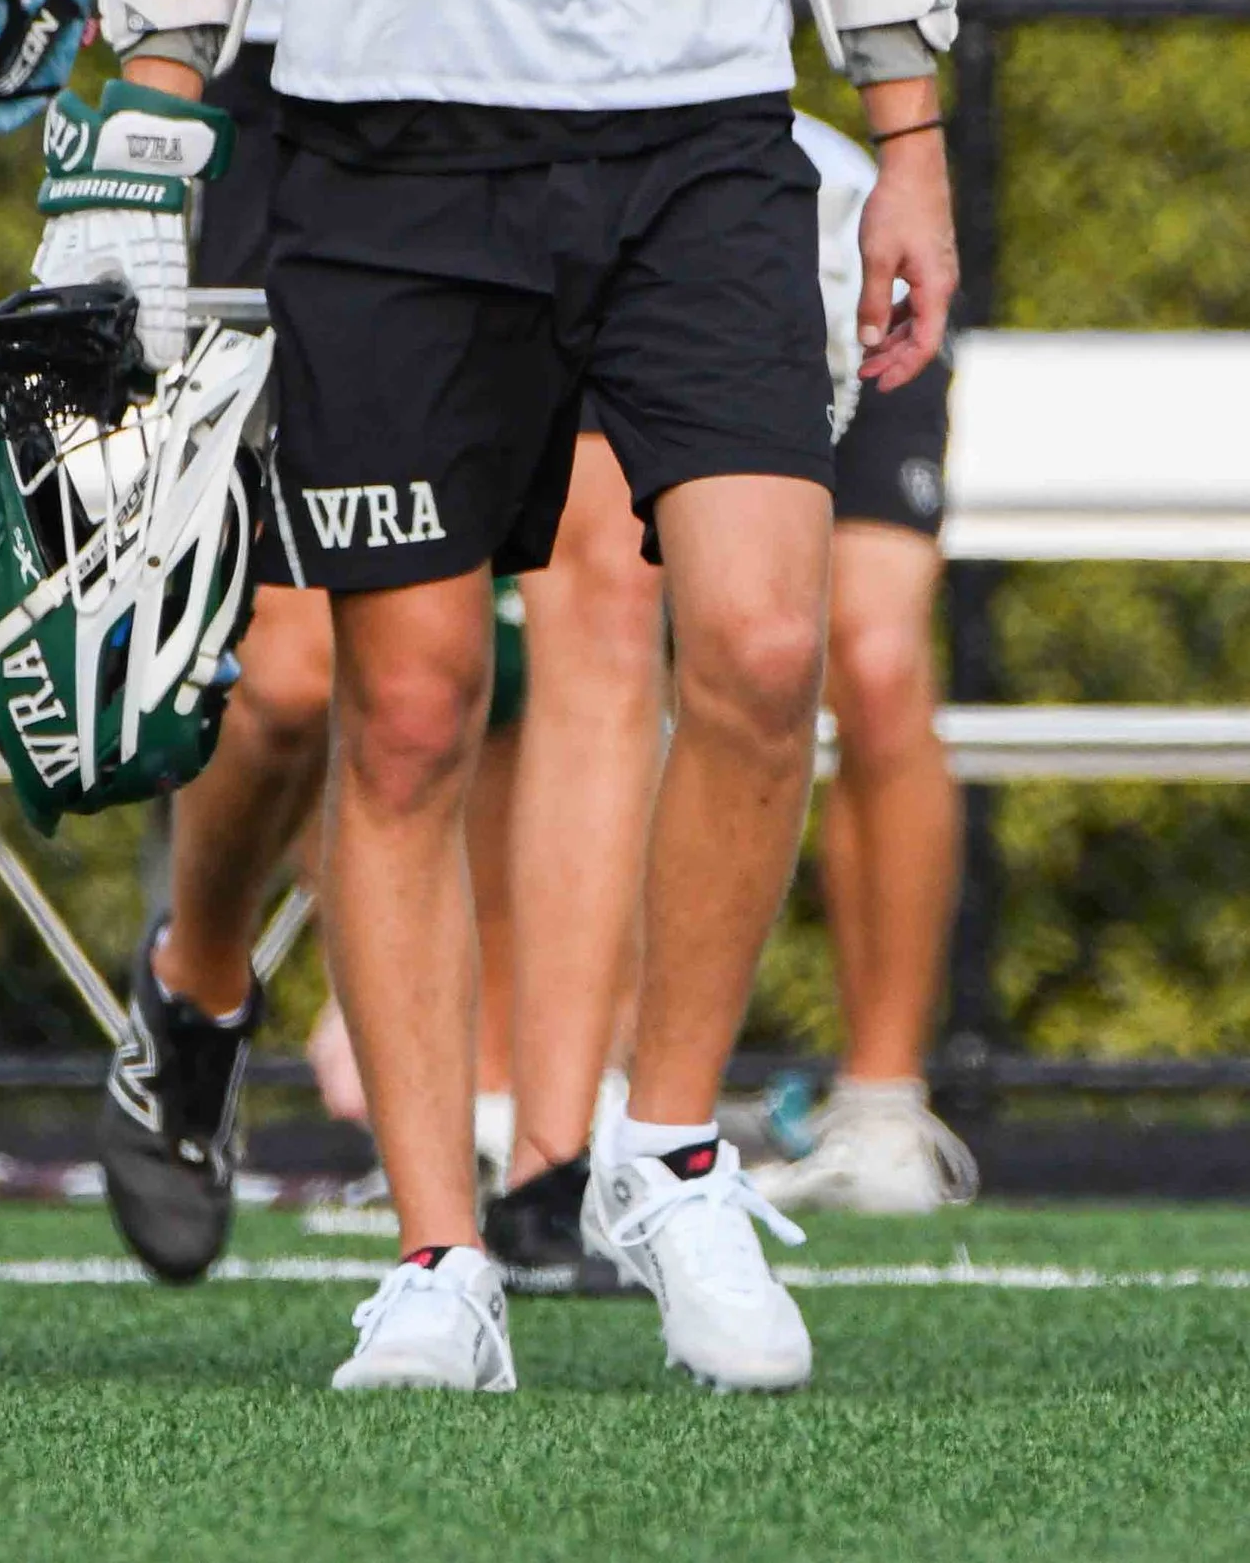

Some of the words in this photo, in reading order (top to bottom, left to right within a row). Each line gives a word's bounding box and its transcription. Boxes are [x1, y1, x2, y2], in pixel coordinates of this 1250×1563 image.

[126, 135, 183, 161] WRA
[50, 178, 166, 203] WARRIOR
[302, 481, 447, 549] WRA
[3, 639, 79, 788] WRA
